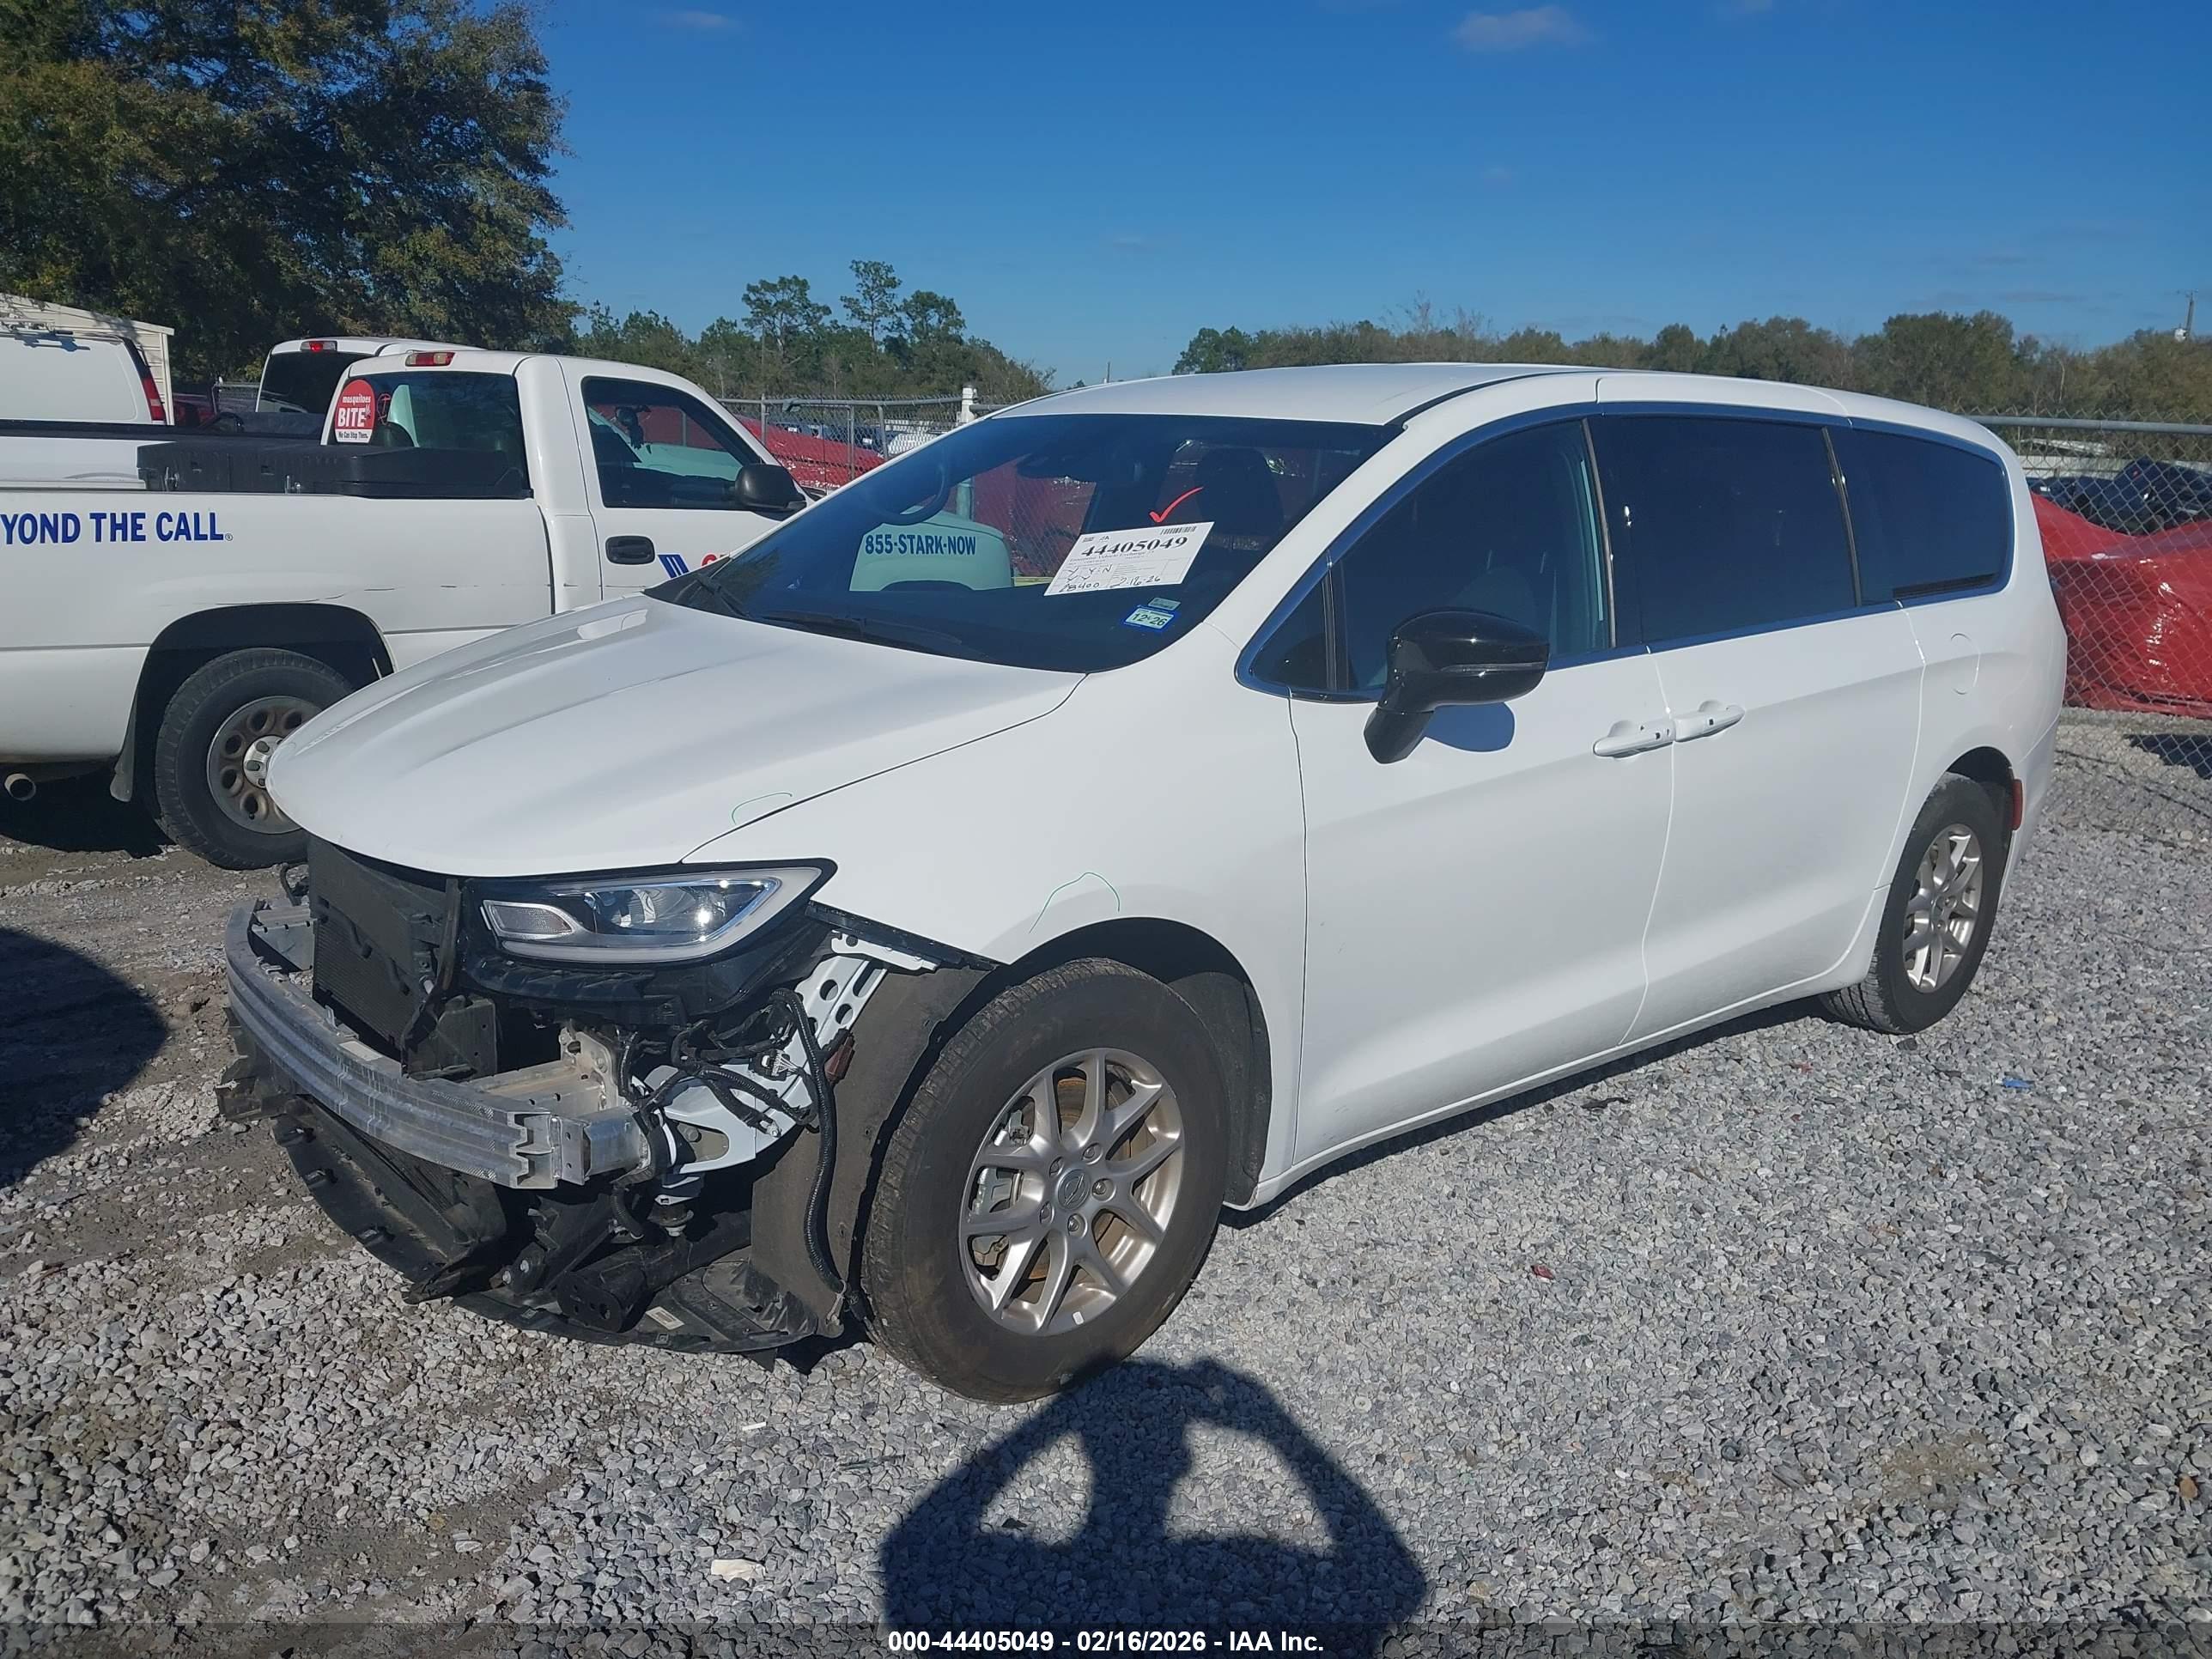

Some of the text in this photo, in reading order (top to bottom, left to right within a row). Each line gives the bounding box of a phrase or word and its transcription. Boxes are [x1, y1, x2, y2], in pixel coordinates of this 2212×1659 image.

[342, 393, 371, 405] mosquitoes
[337, 407, 367, 428] BITE
[89, 512, 147, 543] THE
[865, 533, 976, 556] 855-STARK-NOW
[1080, 536, 1188, 557] 44405049
[1132, 613, 1147, 622] 12
[1149, 617, 1168, 626] 26
